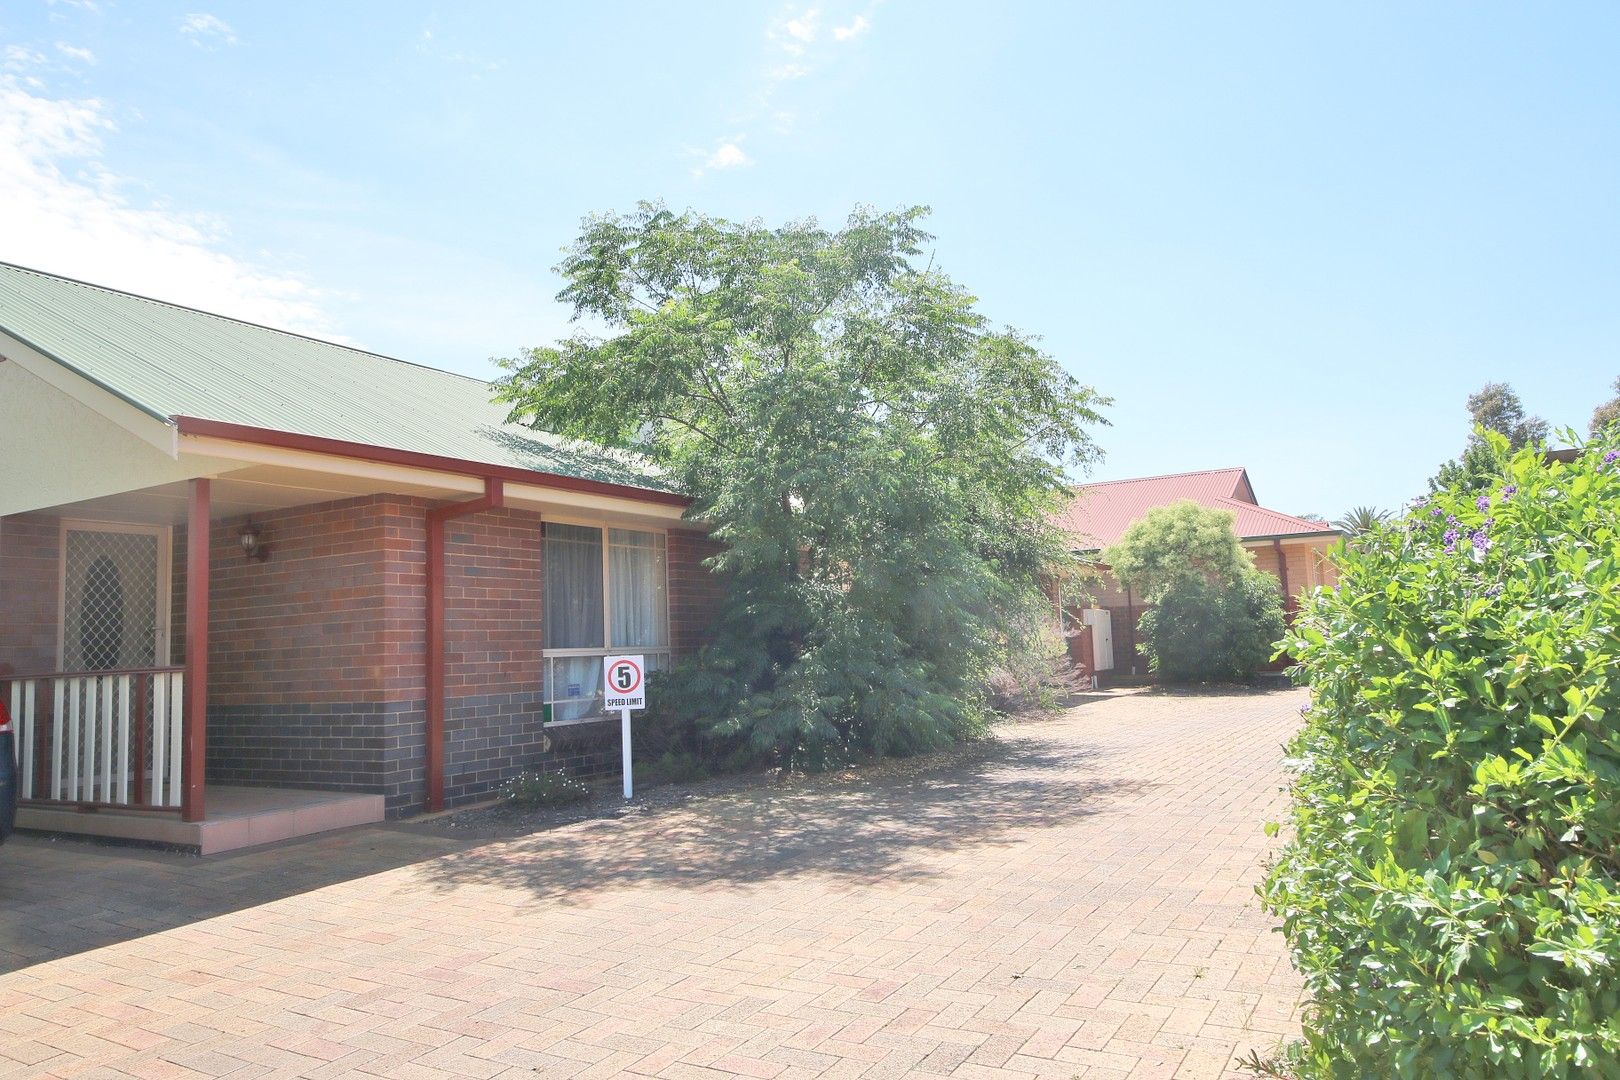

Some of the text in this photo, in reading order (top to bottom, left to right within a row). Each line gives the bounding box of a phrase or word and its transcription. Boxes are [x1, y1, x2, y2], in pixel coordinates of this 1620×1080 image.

[617, 666, 631, 689] 5
[607, 697, 643, 706] SPEED LIMIT
